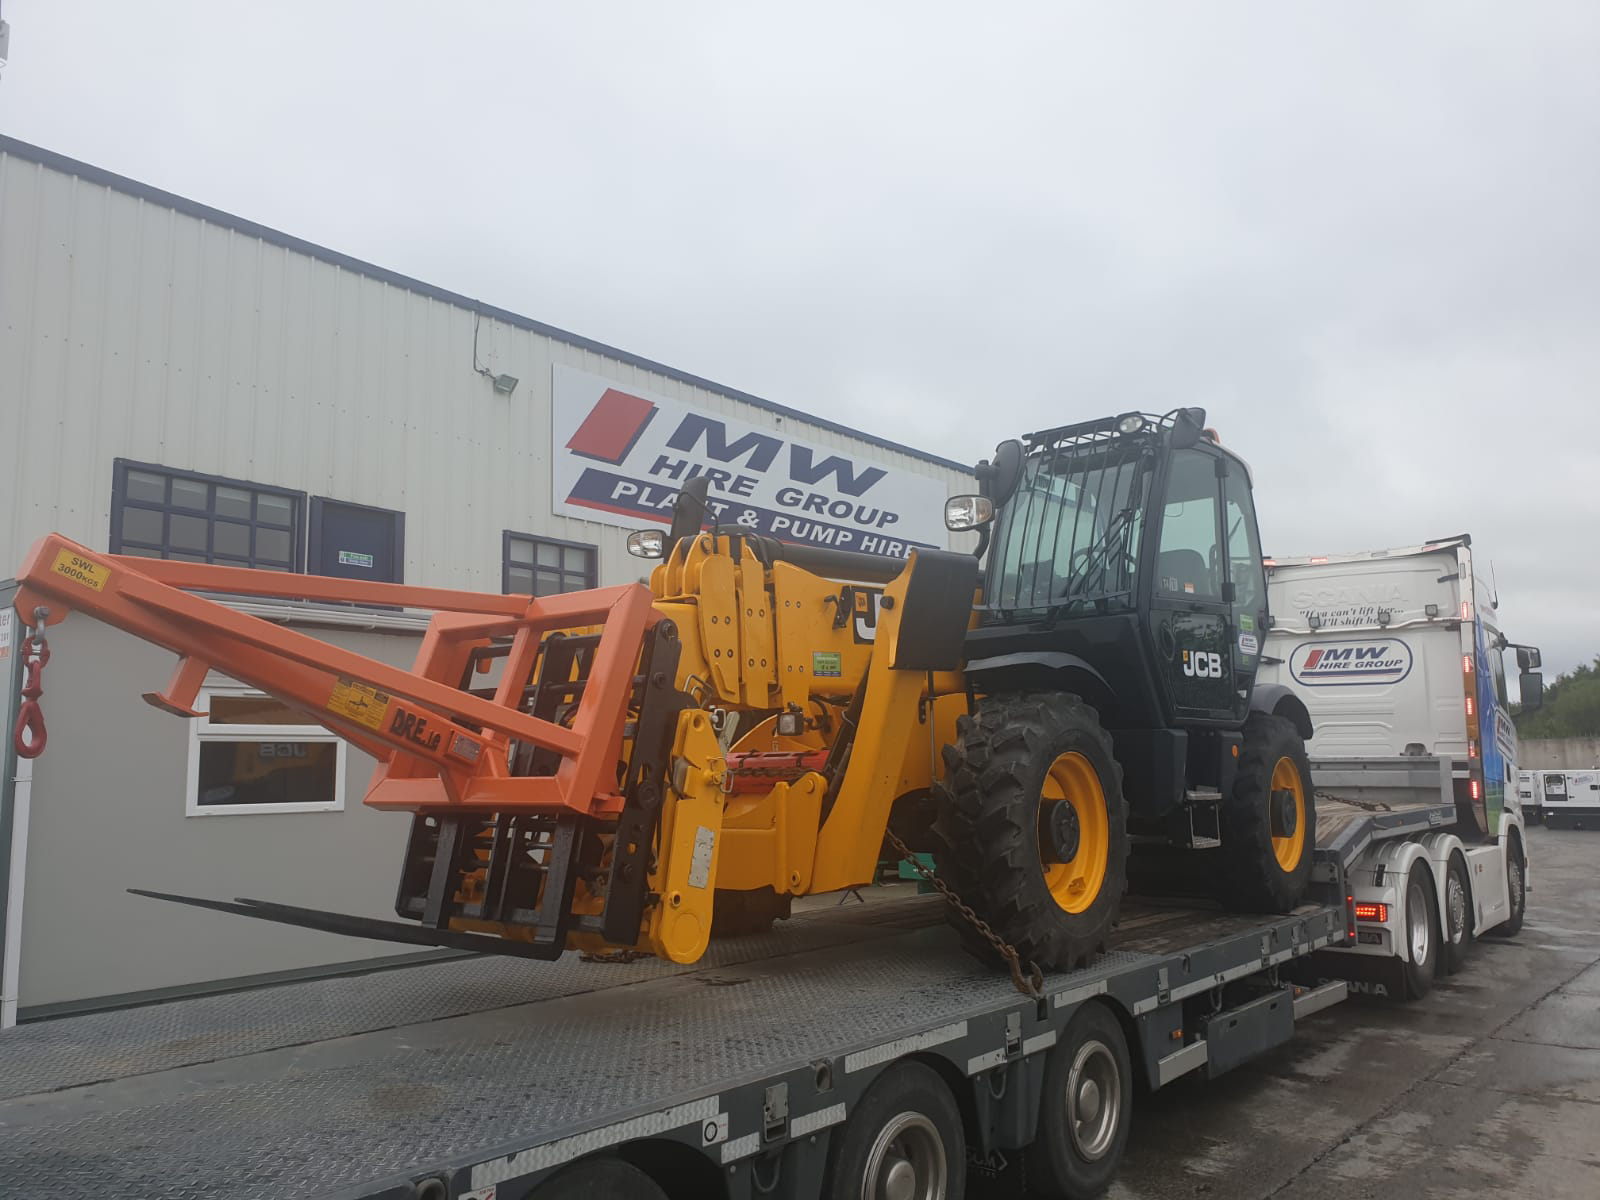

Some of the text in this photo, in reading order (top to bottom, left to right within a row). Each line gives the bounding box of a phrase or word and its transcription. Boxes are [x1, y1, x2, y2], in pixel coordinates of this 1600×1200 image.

[666, 412, 888, 498] MW
[648, 455, 899, 529] HIRE GROUP
[610, 481, 729, 520] PLAT
[737, 509, 760, 529] &
[770, 516, 853, 546] PUMP
[71, 557, 95, 574] SWL
[1183, 650, 1222, 678] JCB
[1318, 659, 1403, 670] HIRE GROUP
[1323, 646, 1389, 661] MW
